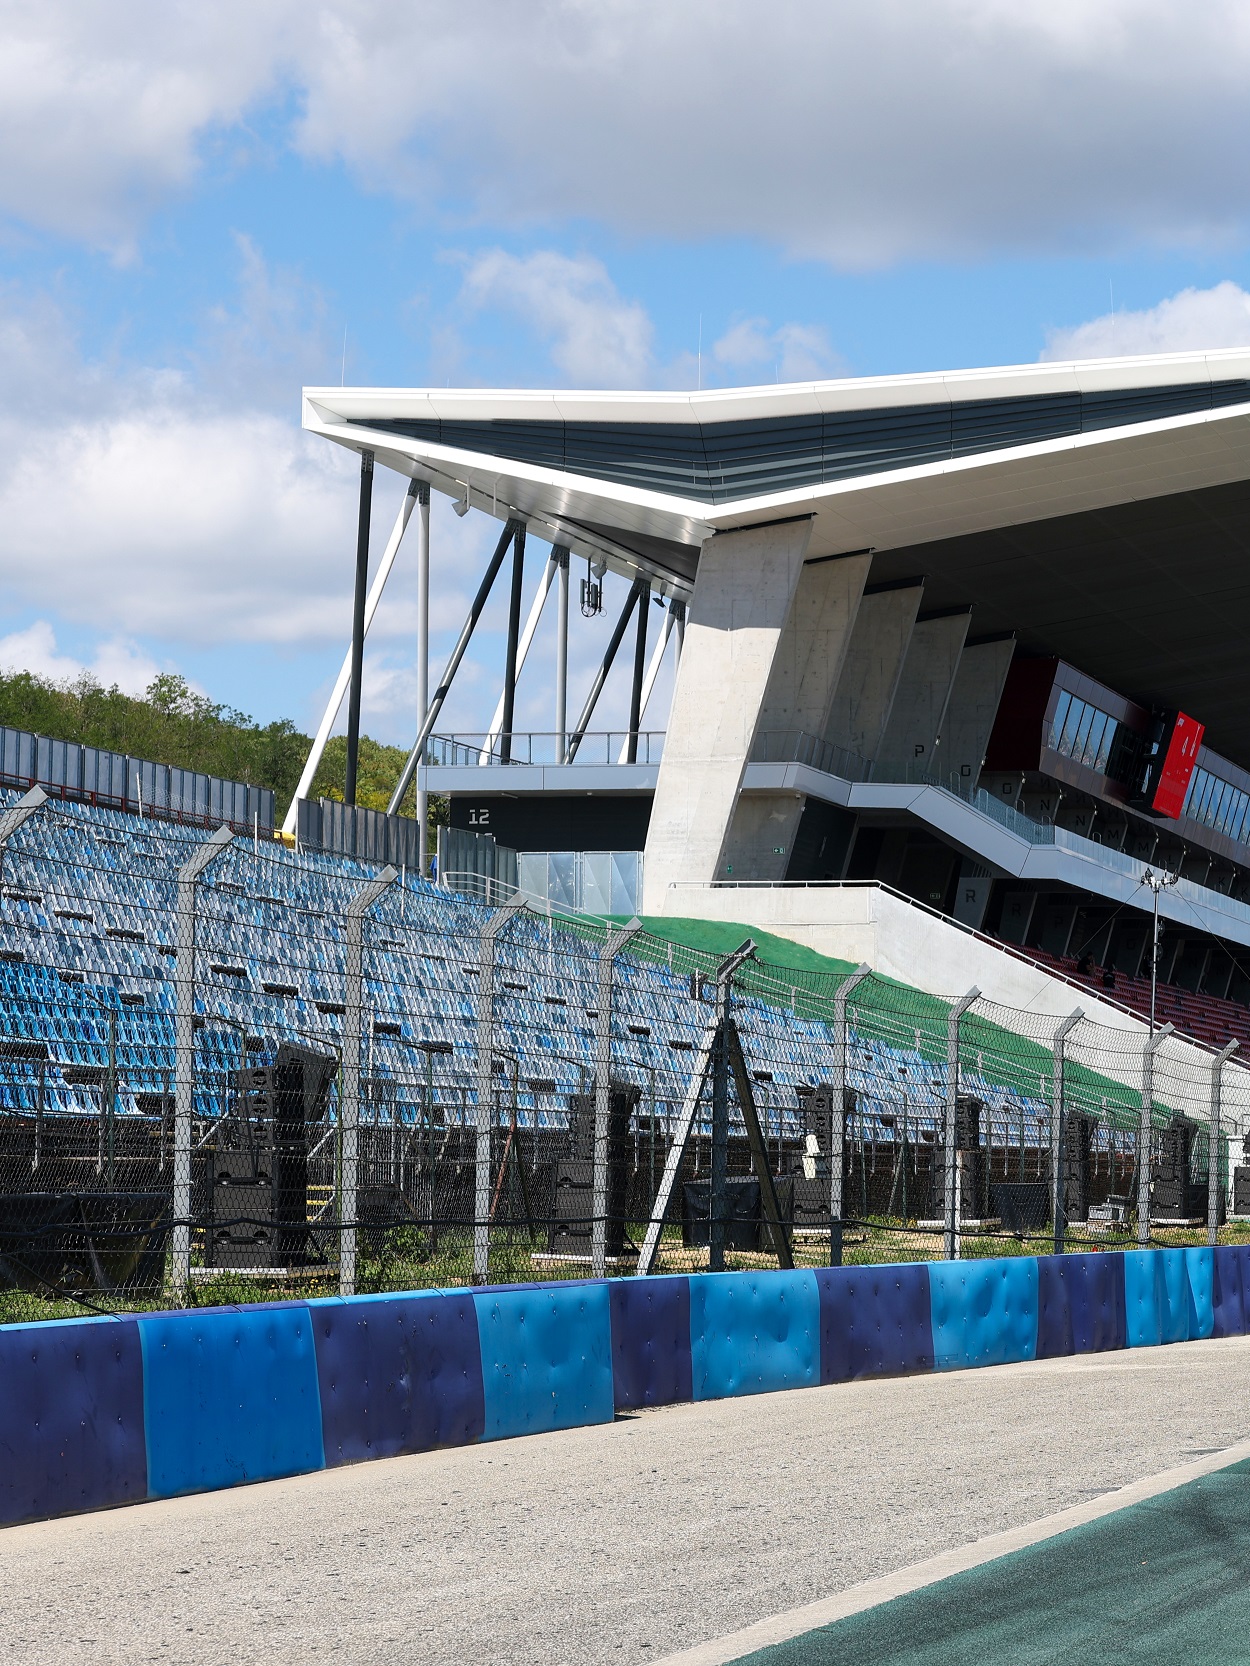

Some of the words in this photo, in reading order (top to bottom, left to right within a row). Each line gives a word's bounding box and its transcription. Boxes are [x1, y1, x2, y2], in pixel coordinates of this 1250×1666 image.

[915, 745, 924, 757] P
[1040, 800, 1050, 811] N
[468, 809, 490, 825] 12
[1076, 815, 1085, 825] N
[965, 889, 976, 902] R
